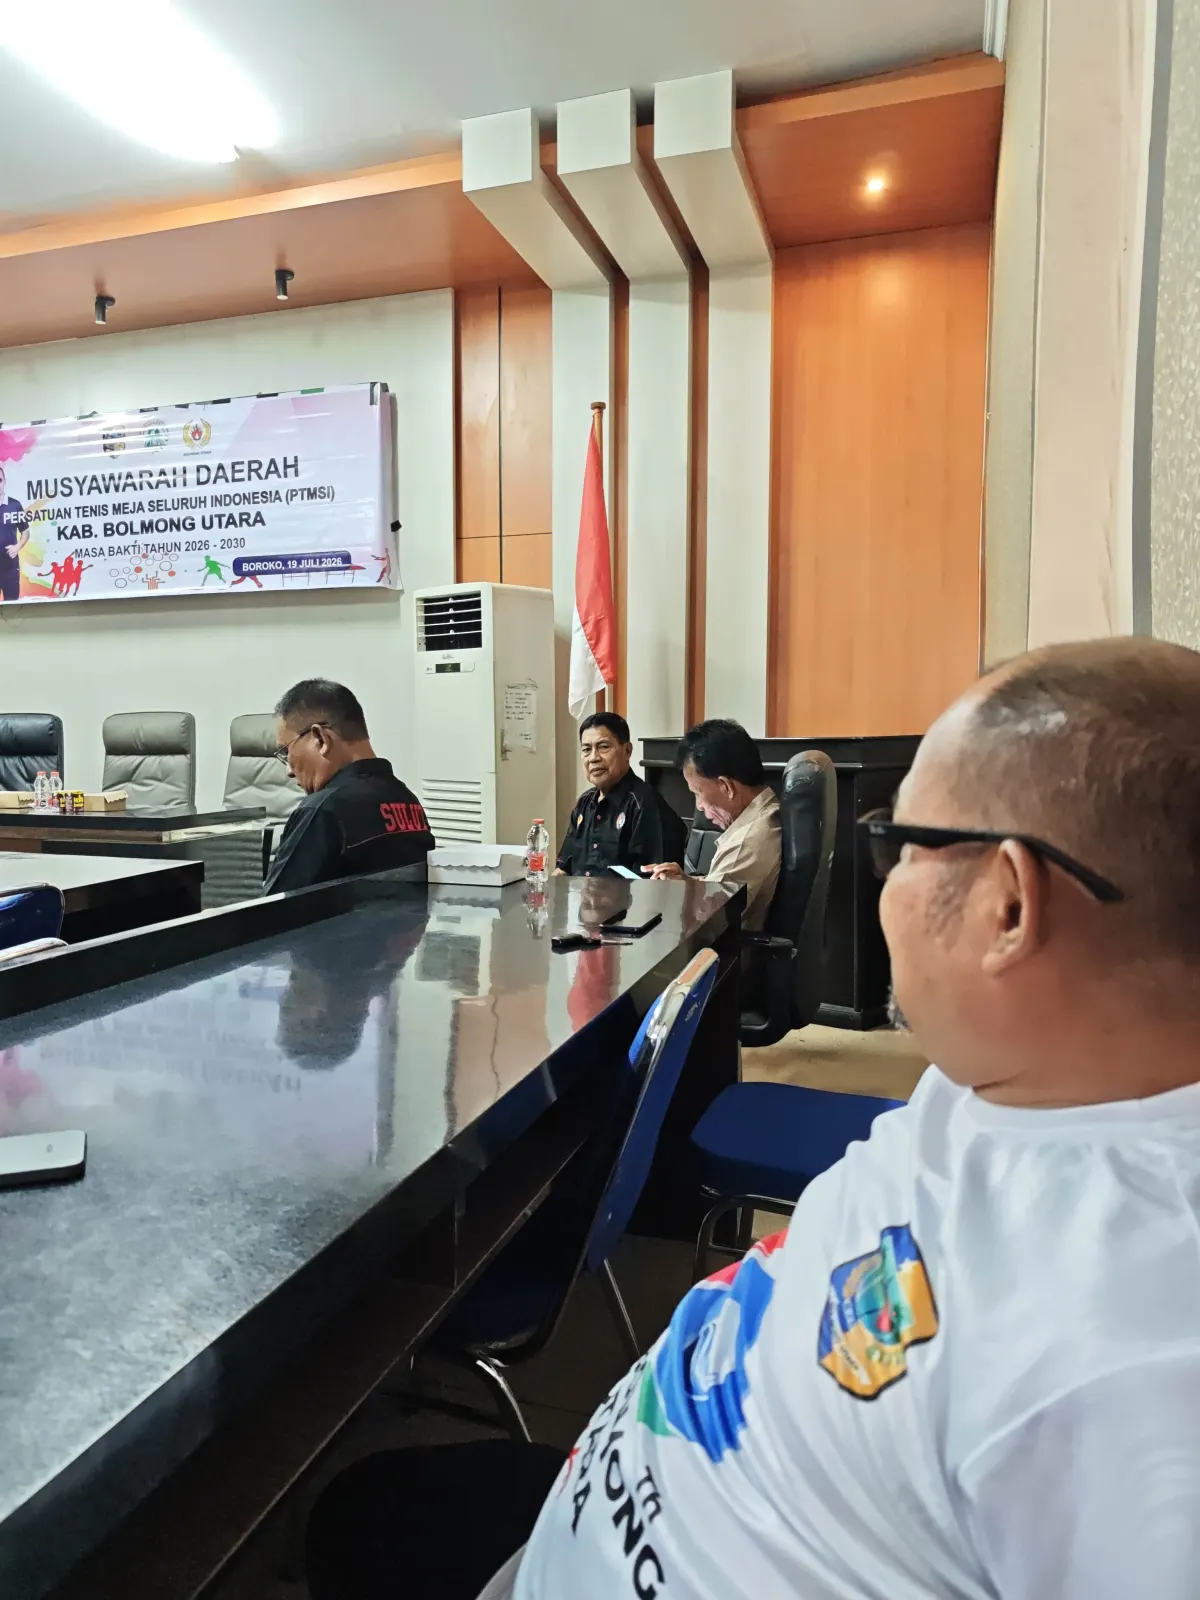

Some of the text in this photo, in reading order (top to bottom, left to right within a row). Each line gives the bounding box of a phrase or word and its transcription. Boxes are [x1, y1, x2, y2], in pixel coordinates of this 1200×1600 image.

[27, 456, 299, 500] MUSYAWARAH DAERAH
[3, 485, 335, 524] PERSATUAN TENIS MEJA SELURUH INDONESIA (PTMSI)
[57, 511, 266, 540] KAB. BOLMONG UTARA
[75, 548, 105, 558] MASA
[108, 545, 141, 557] BAKTI
[144, 542, 181, 554] TAHUN
[185, 540, 210, 551] 2026
[220, 537, 246, 549] 2030
[242, 557, 343, 572] BOROKO, 19 JULI 2026
